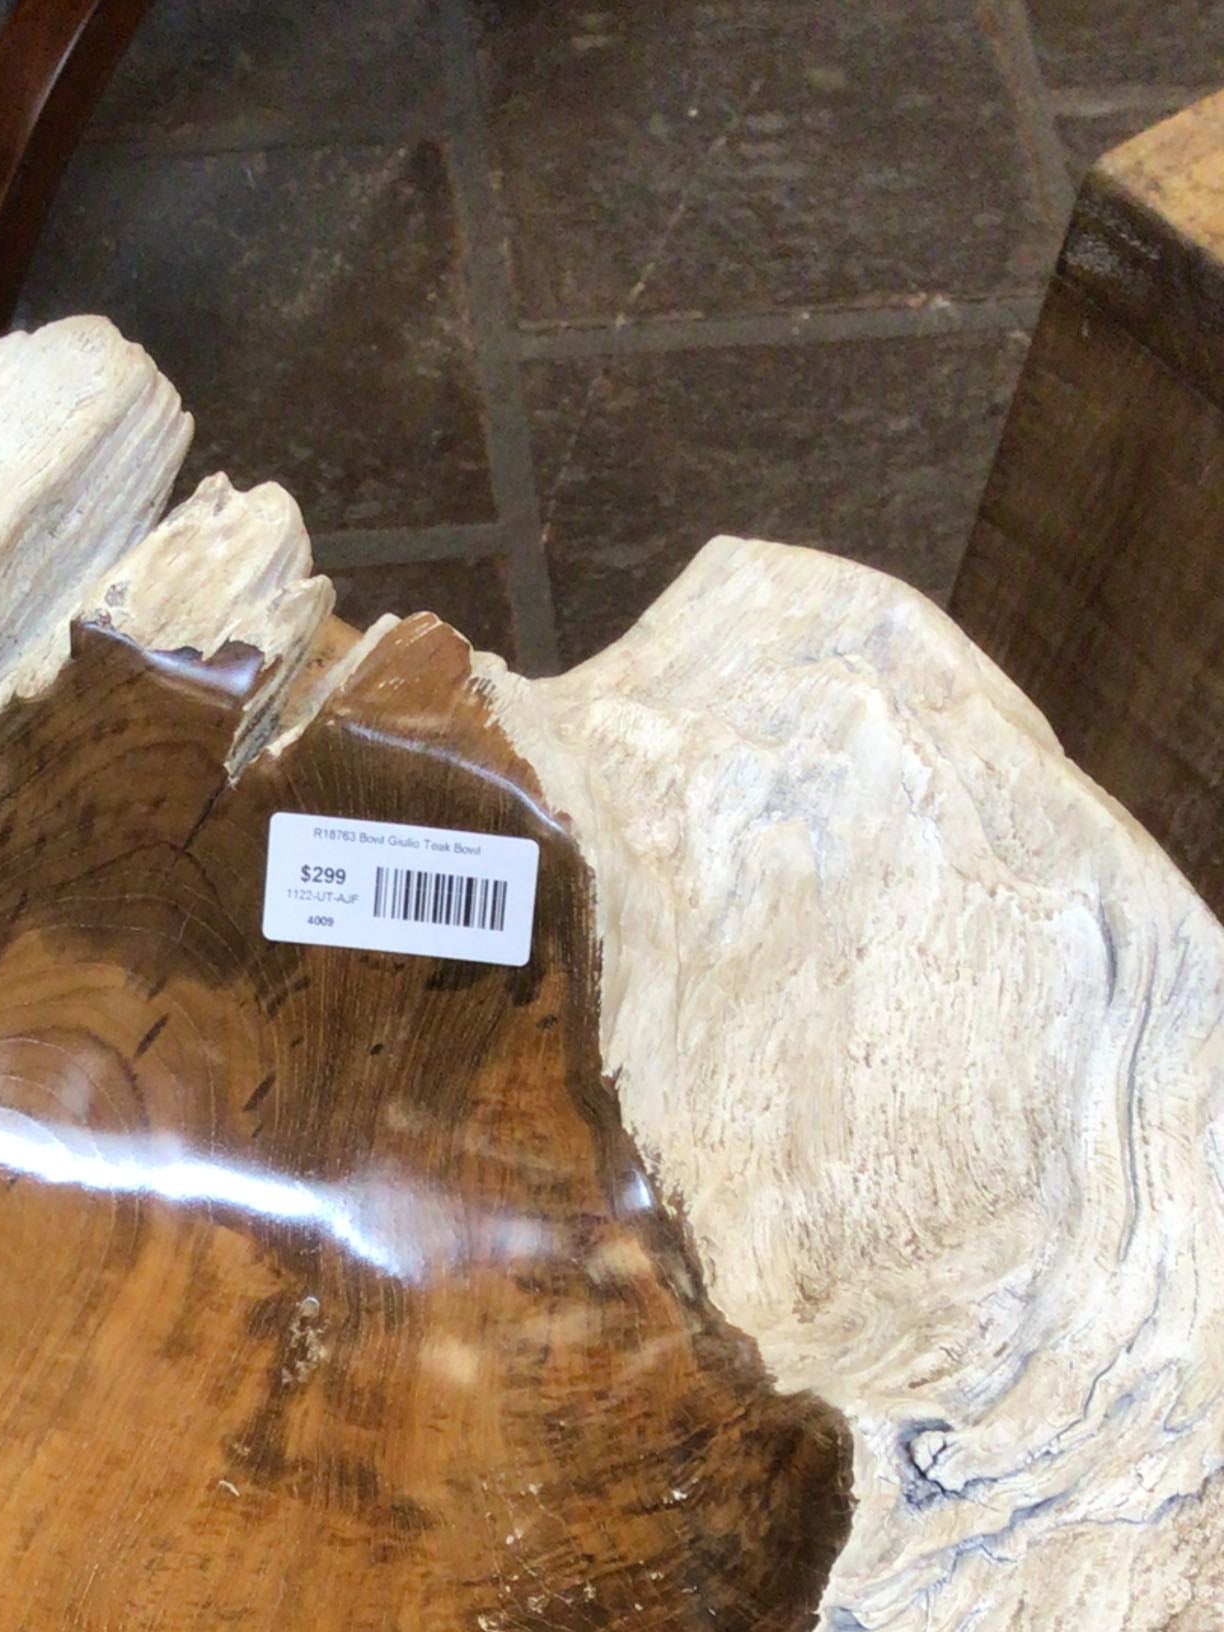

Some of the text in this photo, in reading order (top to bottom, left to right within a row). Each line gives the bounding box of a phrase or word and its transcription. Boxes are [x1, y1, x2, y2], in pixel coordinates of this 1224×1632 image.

[313, 828, 355, 842] R18763
[359, 831, 384, 844] Bowl
[424, 839, 450, 852] Teak
[455, 843, 481, 856] Bowl
[300, 864, 346, 885] $299
[307, 915, 334, 927] 4009
